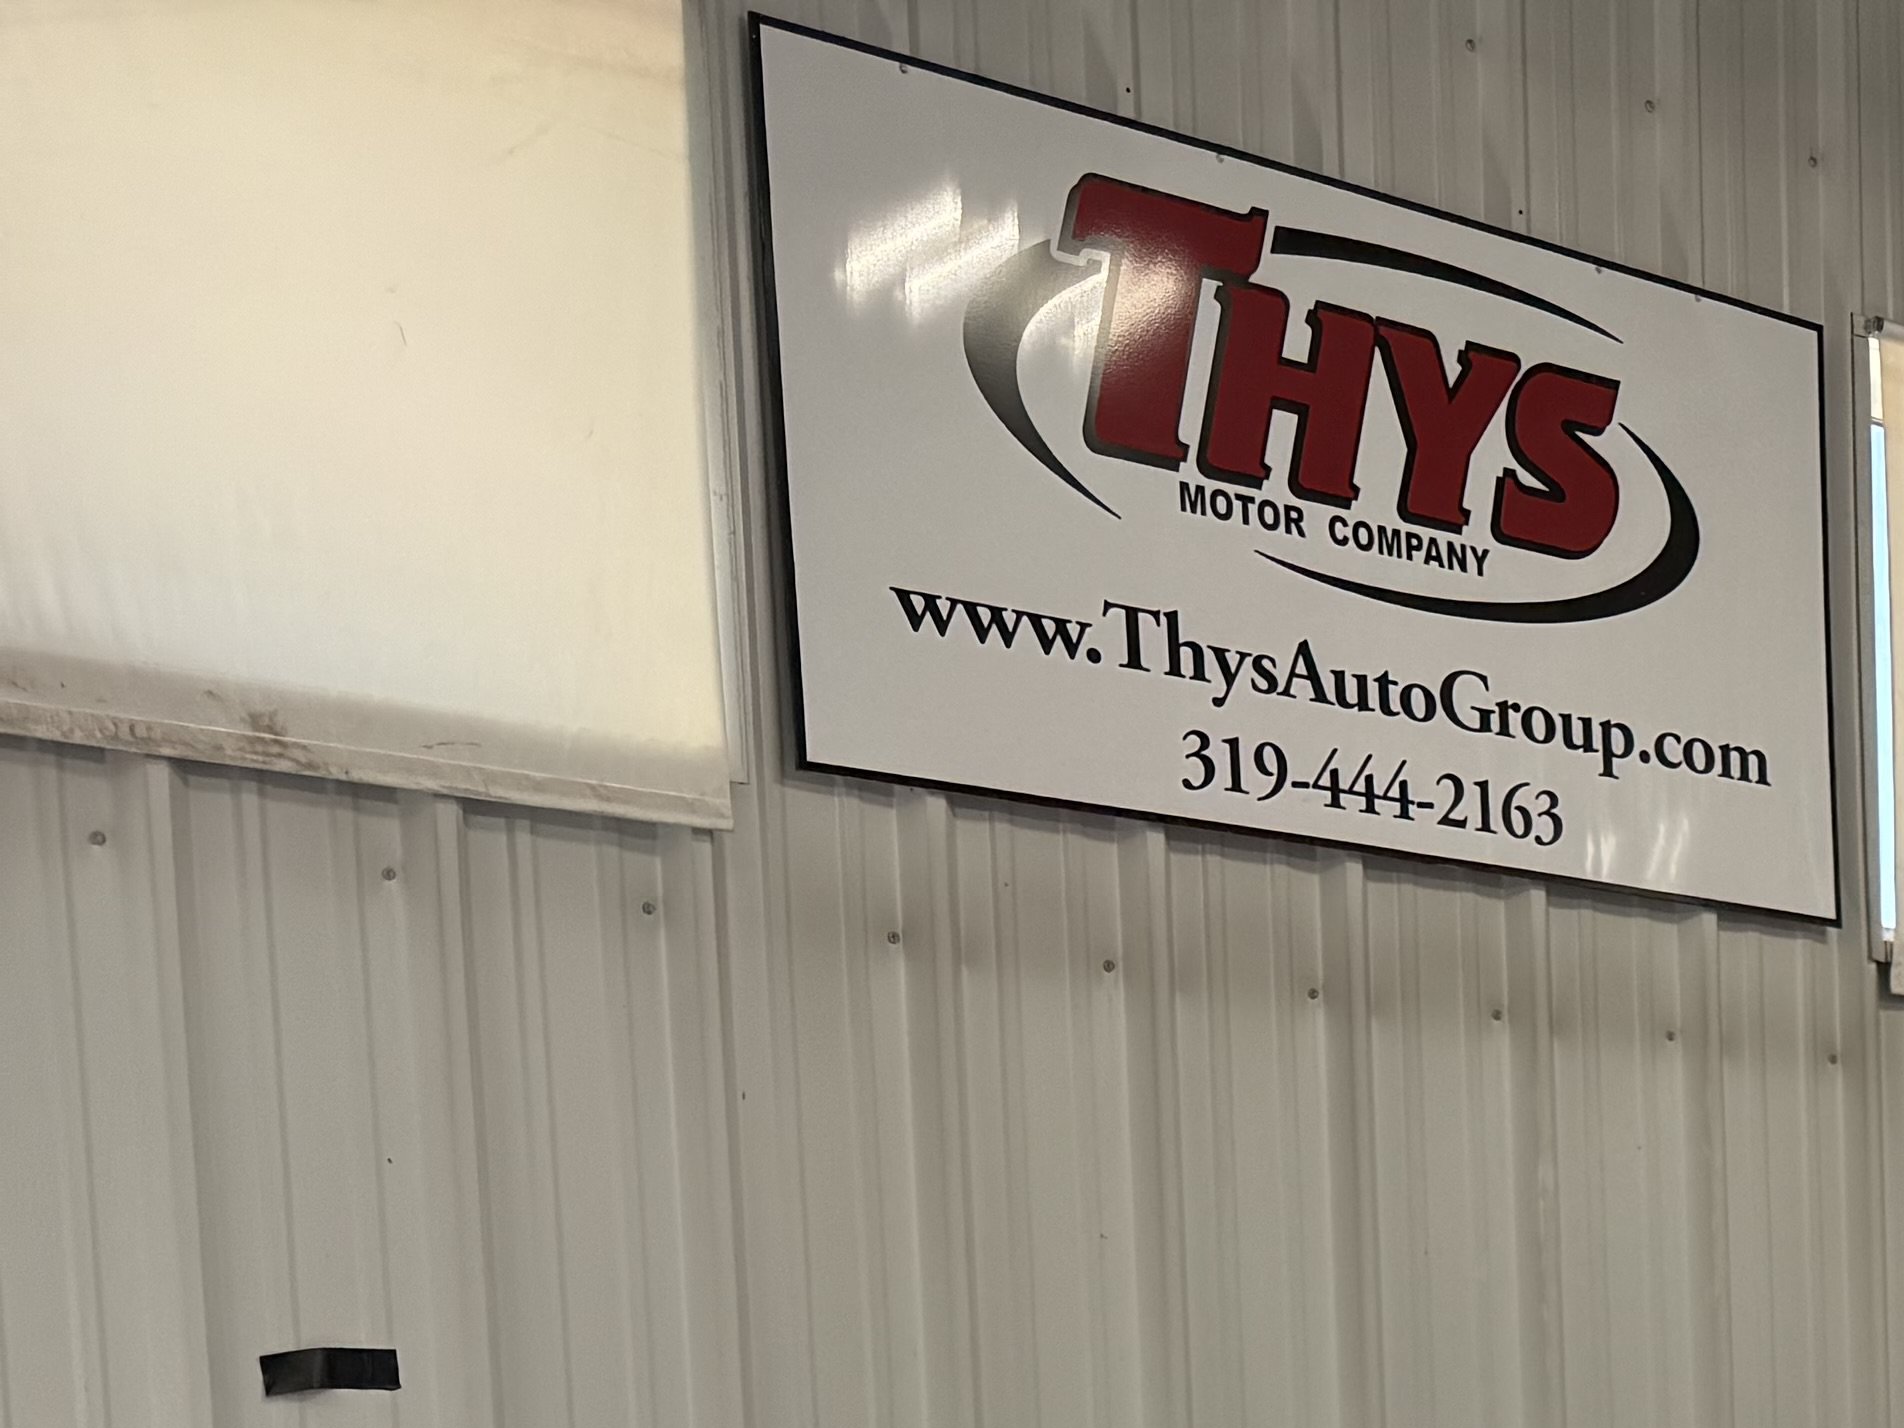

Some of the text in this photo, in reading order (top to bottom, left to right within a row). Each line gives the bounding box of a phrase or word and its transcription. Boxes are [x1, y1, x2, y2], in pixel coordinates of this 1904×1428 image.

[1057, 172, 1620, 560] THYS
[1178, 480, 1491, 578] MOTOR COMPANY
[888, 586, 1772, 787] www.ThysAutoGroup.com
[1180, 729, 1564, 847] 319-444-2163
